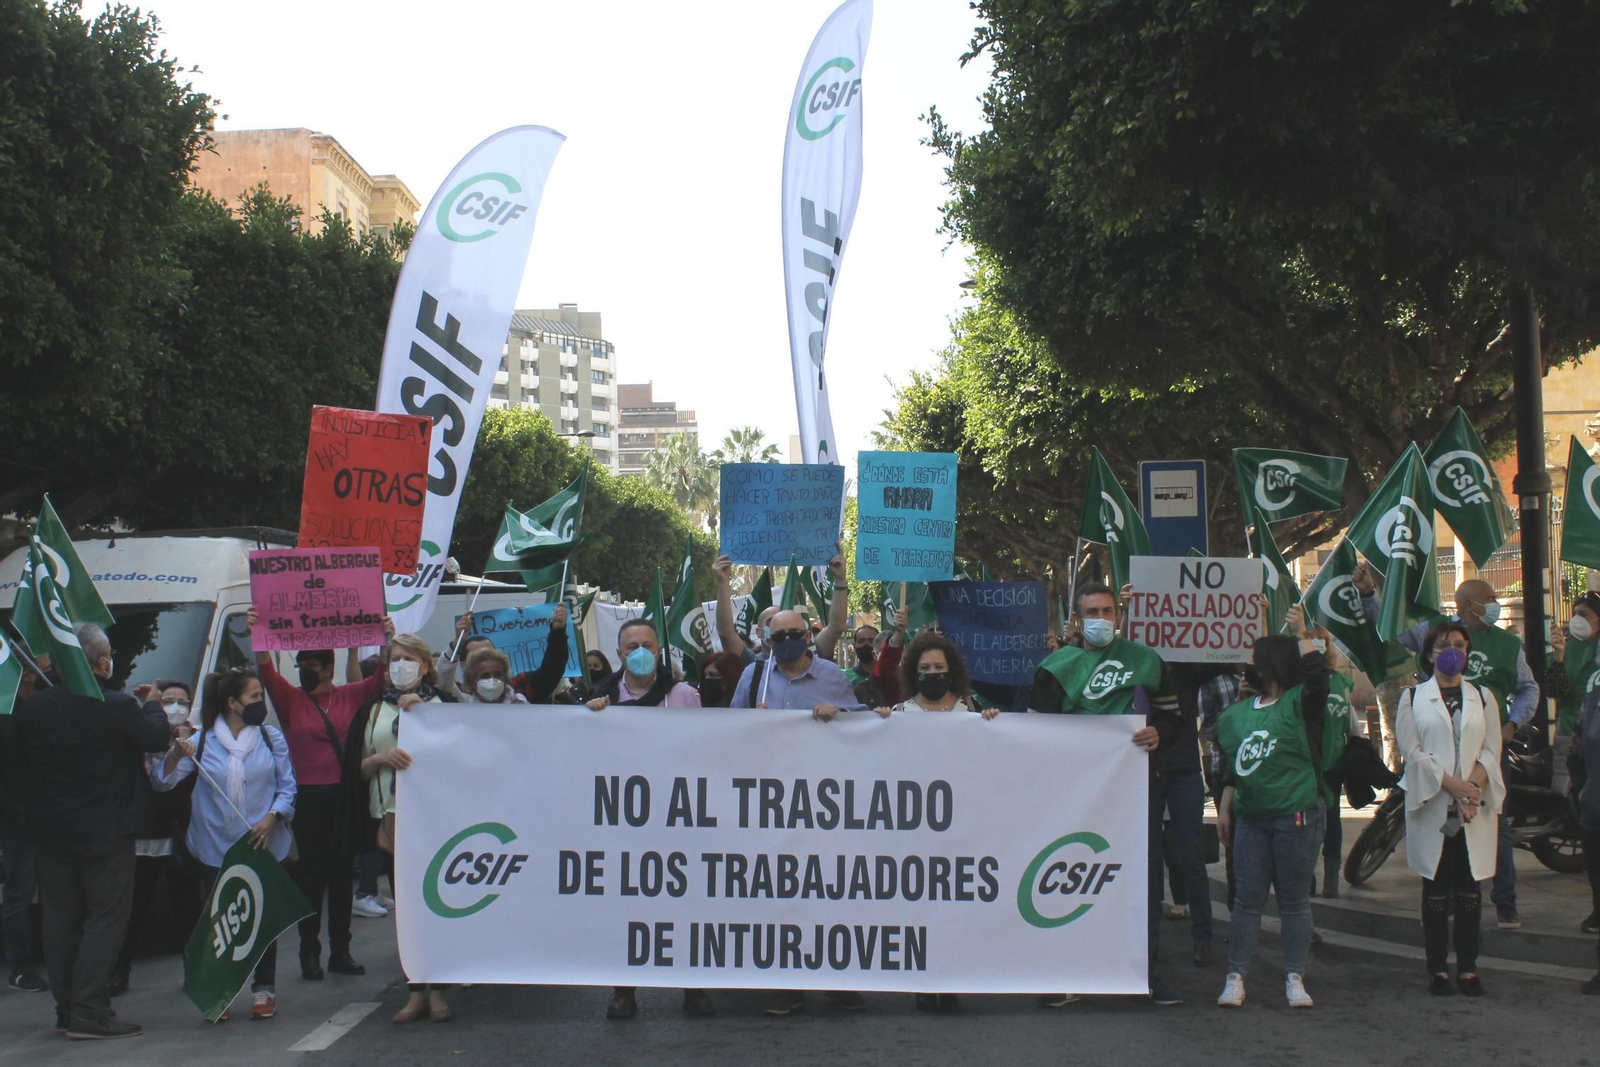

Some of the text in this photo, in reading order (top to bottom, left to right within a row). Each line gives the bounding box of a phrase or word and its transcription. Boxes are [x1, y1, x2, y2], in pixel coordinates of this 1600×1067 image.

[808, 78, 862, 115] CSIF
[455, 191, 528, 226] CSIF
[400, 289, 483, 497] CSIF
[314, 437, 349, 471] HAY
[334, 467, 424, 506] OTRAS
[726, 467, 839, 485] COMO SE PUEDE
[913, 466, 949, 485] ESTÁ
[1445, 463, 1491, 506] CSIF
[725, 488, 770, 505] HACER
[774, 487, 810, 504] TANTO
[883, 486, 933, 511] AHORA
[304, 512, 421, 548] SOLUCIONES
[725, 509, 735, 527] A
[739, 510, 759, 526] LOS
[858, 516, 907, 535] NUESTRO
[724, 525, 839, 547] HABIENDO OTRAS
[250, 553, 380, 575] NUESTRO ALBERGUE
[731, 545, 835, 562] SOLUCIONES
[863, 547, 880, 565] DE
[303, 574, 325, 589] de
[1179, 561, 1226, 590] NO
[940, 586, 1037, 607] UNA DECISIÓN
[1132, 592, 1260, 620] TRASLADOS
[269, 609, 382, 630] sin traslados
[265, 626, 377, 651] FORZOSOS
[973, 633, 989, 651] EL
[990, 632, 1049, 652] ALBERGUE
[1130, 621, 1258, 649] FORZOSOS
[973, 657, 1035, 675] ALMERÍA
[593, 774, 954, 832] NO AL TRASLADO
[444, 851, 530, 886] CSIF
[558, 850, 1000, 903] DE LOS TRABAJADORES
[1037, 861, 1123, 896] CSIF
[213, 888, 251, 960] CSIF
[627, 921, 927, 972] DE INTURJOVEN
